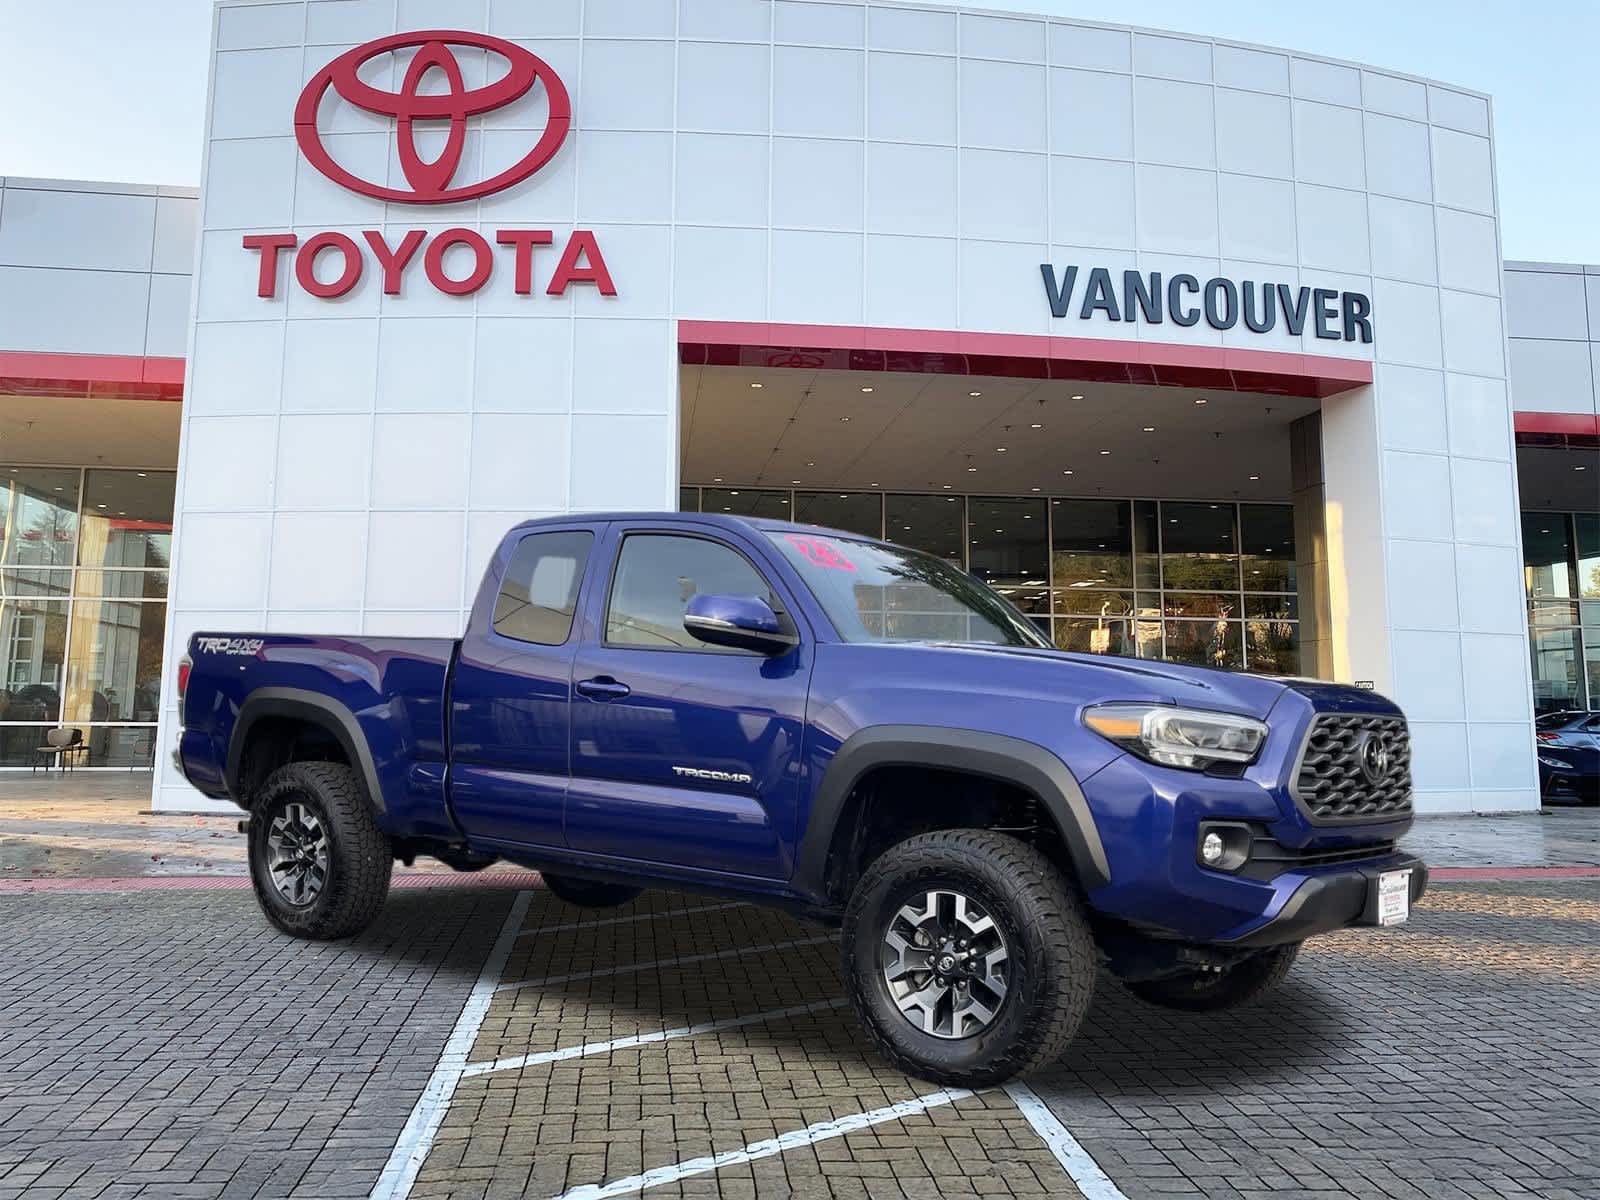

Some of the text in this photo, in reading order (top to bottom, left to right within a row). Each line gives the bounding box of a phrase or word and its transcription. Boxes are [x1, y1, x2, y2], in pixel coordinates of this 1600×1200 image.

[243, 228, 617, 298] TOYOTA
[1040, 264, 1373, 343] VANCOUVER
[197, 637, 231, 654] TRD
[672, 766, 752, 784] TACOMA
